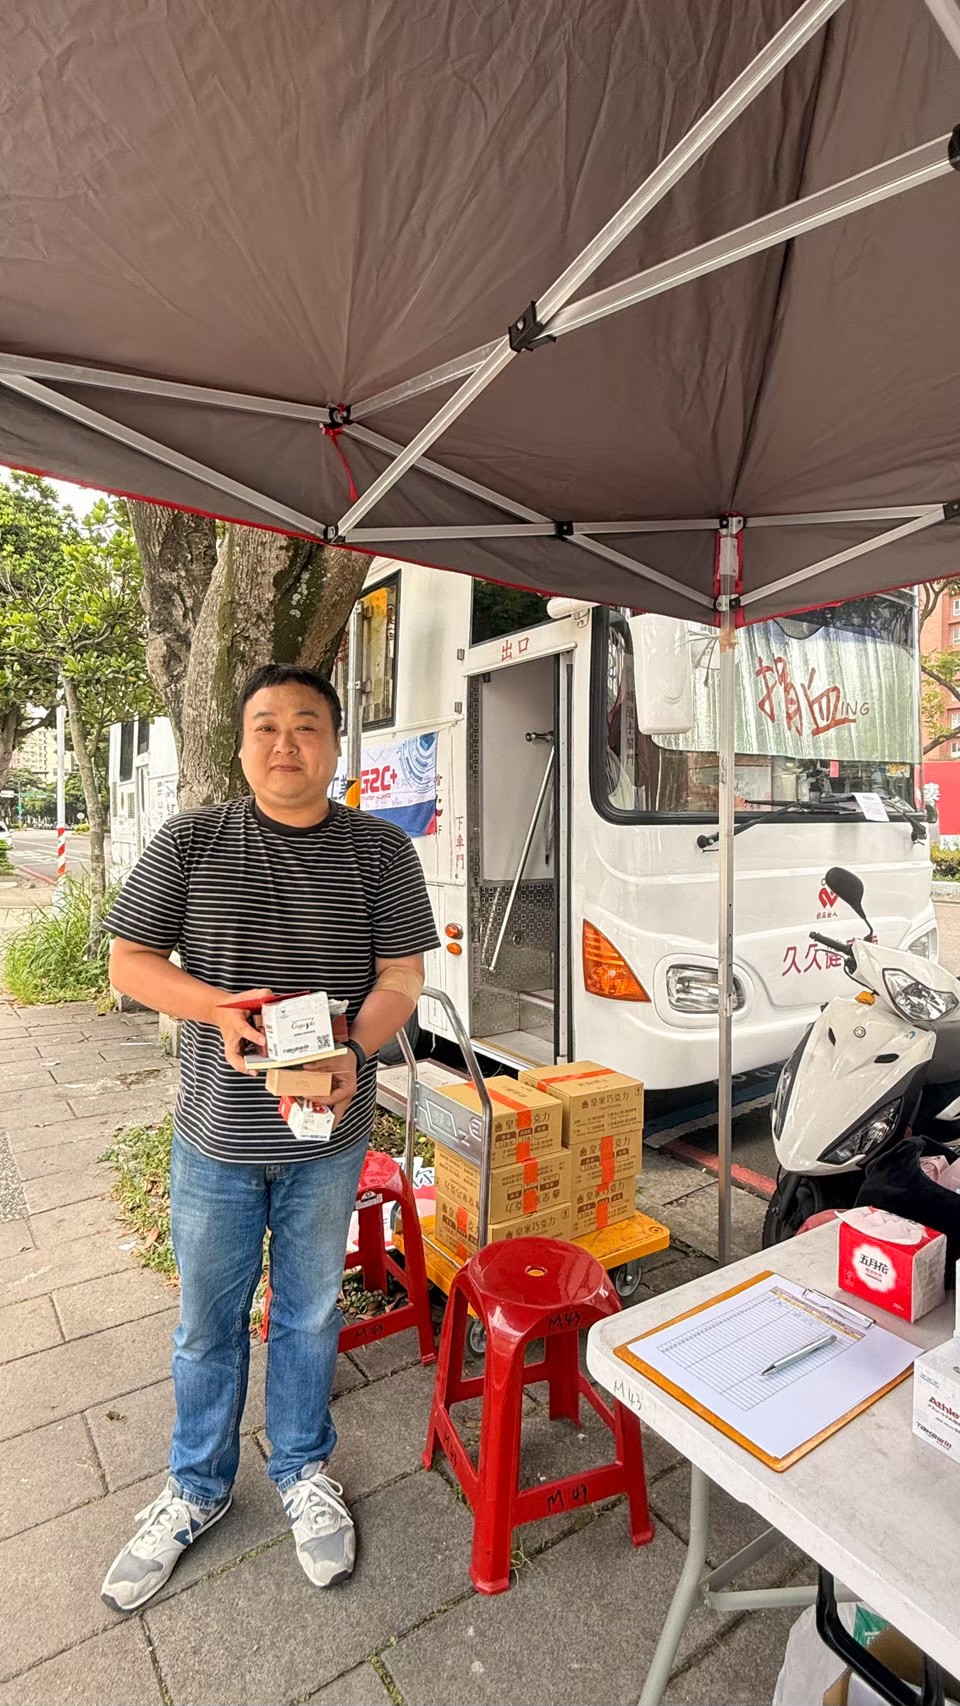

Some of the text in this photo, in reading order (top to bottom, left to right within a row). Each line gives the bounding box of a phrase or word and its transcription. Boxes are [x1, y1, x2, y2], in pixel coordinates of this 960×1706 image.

[502, 637, 530, 661] 出口
[455, 815, 465, 870] 下車門
[859, 1253, 890, 1275] 五月花
[613, 1379, 642, 1411] M 43
[547, 1489, 565, 1511] M
